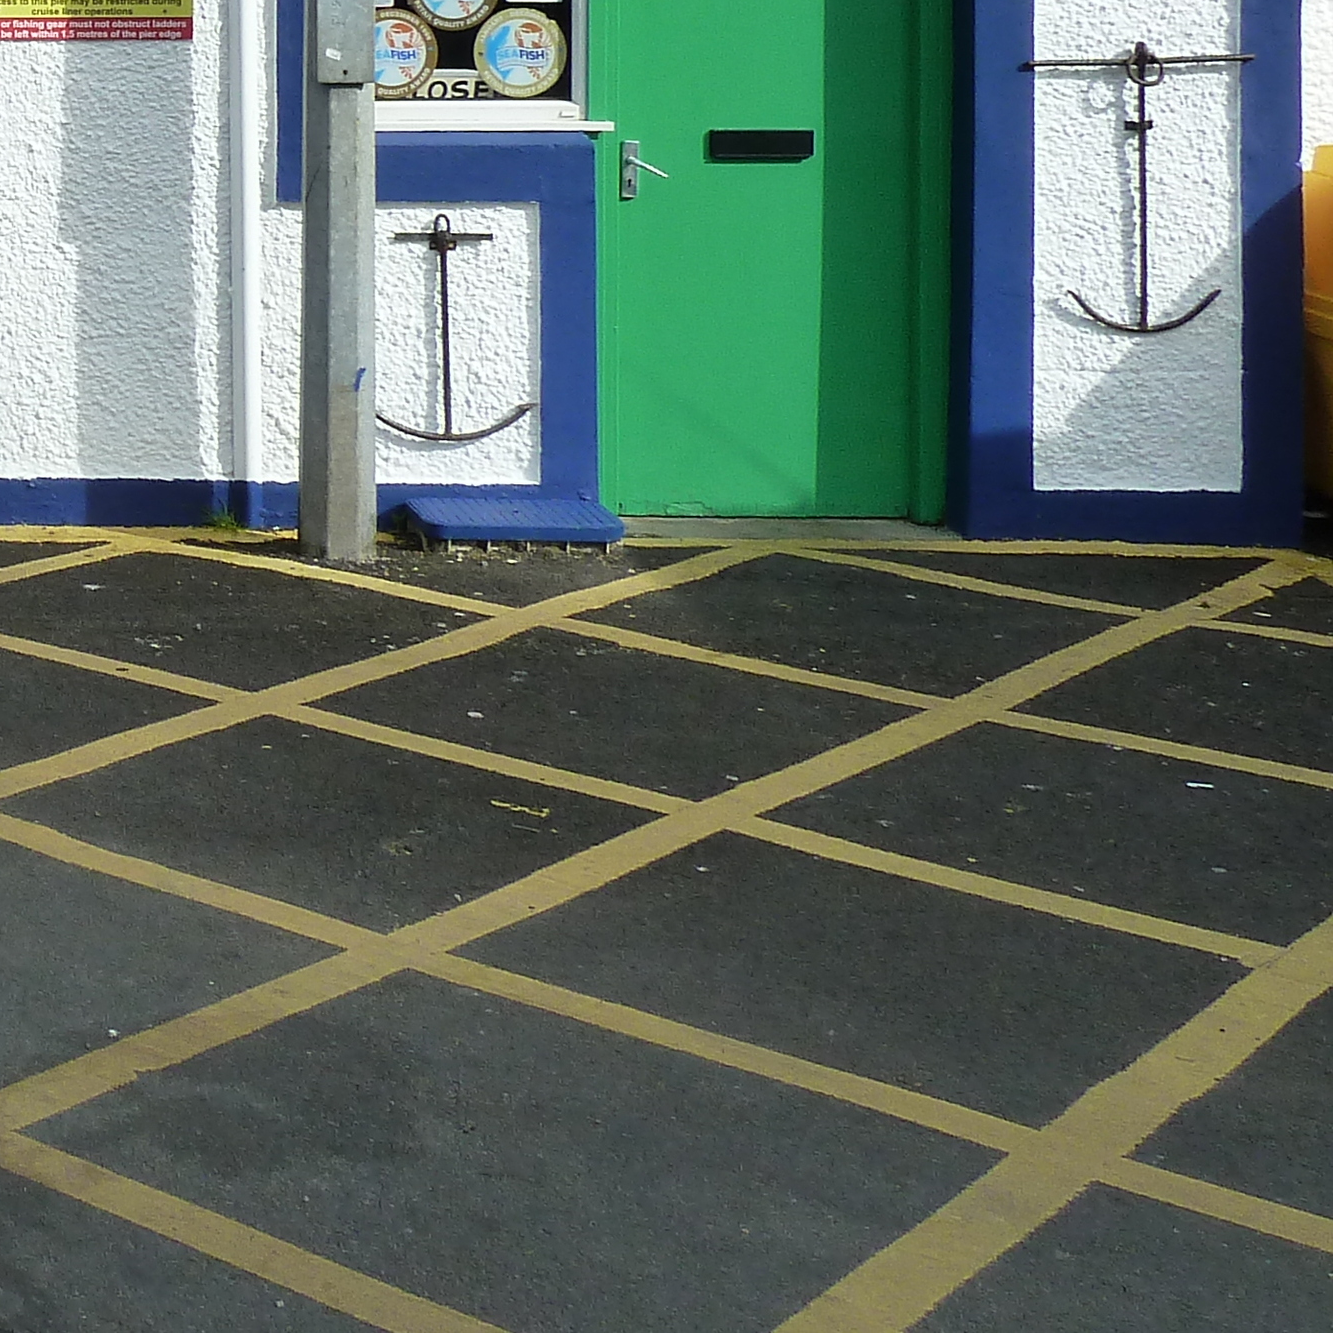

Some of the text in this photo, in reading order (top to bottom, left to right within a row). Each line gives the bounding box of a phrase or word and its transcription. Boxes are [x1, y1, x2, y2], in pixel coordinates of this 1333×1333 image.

[84, 8, 133, 16] operations
[13, 20, 44, 29] fishing
[46, 21, 67, 29] gear
[152, 19, 186, 27] ladders
[14, 30, 28, 38] left
[31, 30, 58, 38] within
[61, 30, 74, 38] 1.5
[122, 29, 136, 37] the
[139, 29, 156, 38] pier
[159, 29, 181, 38] edge
